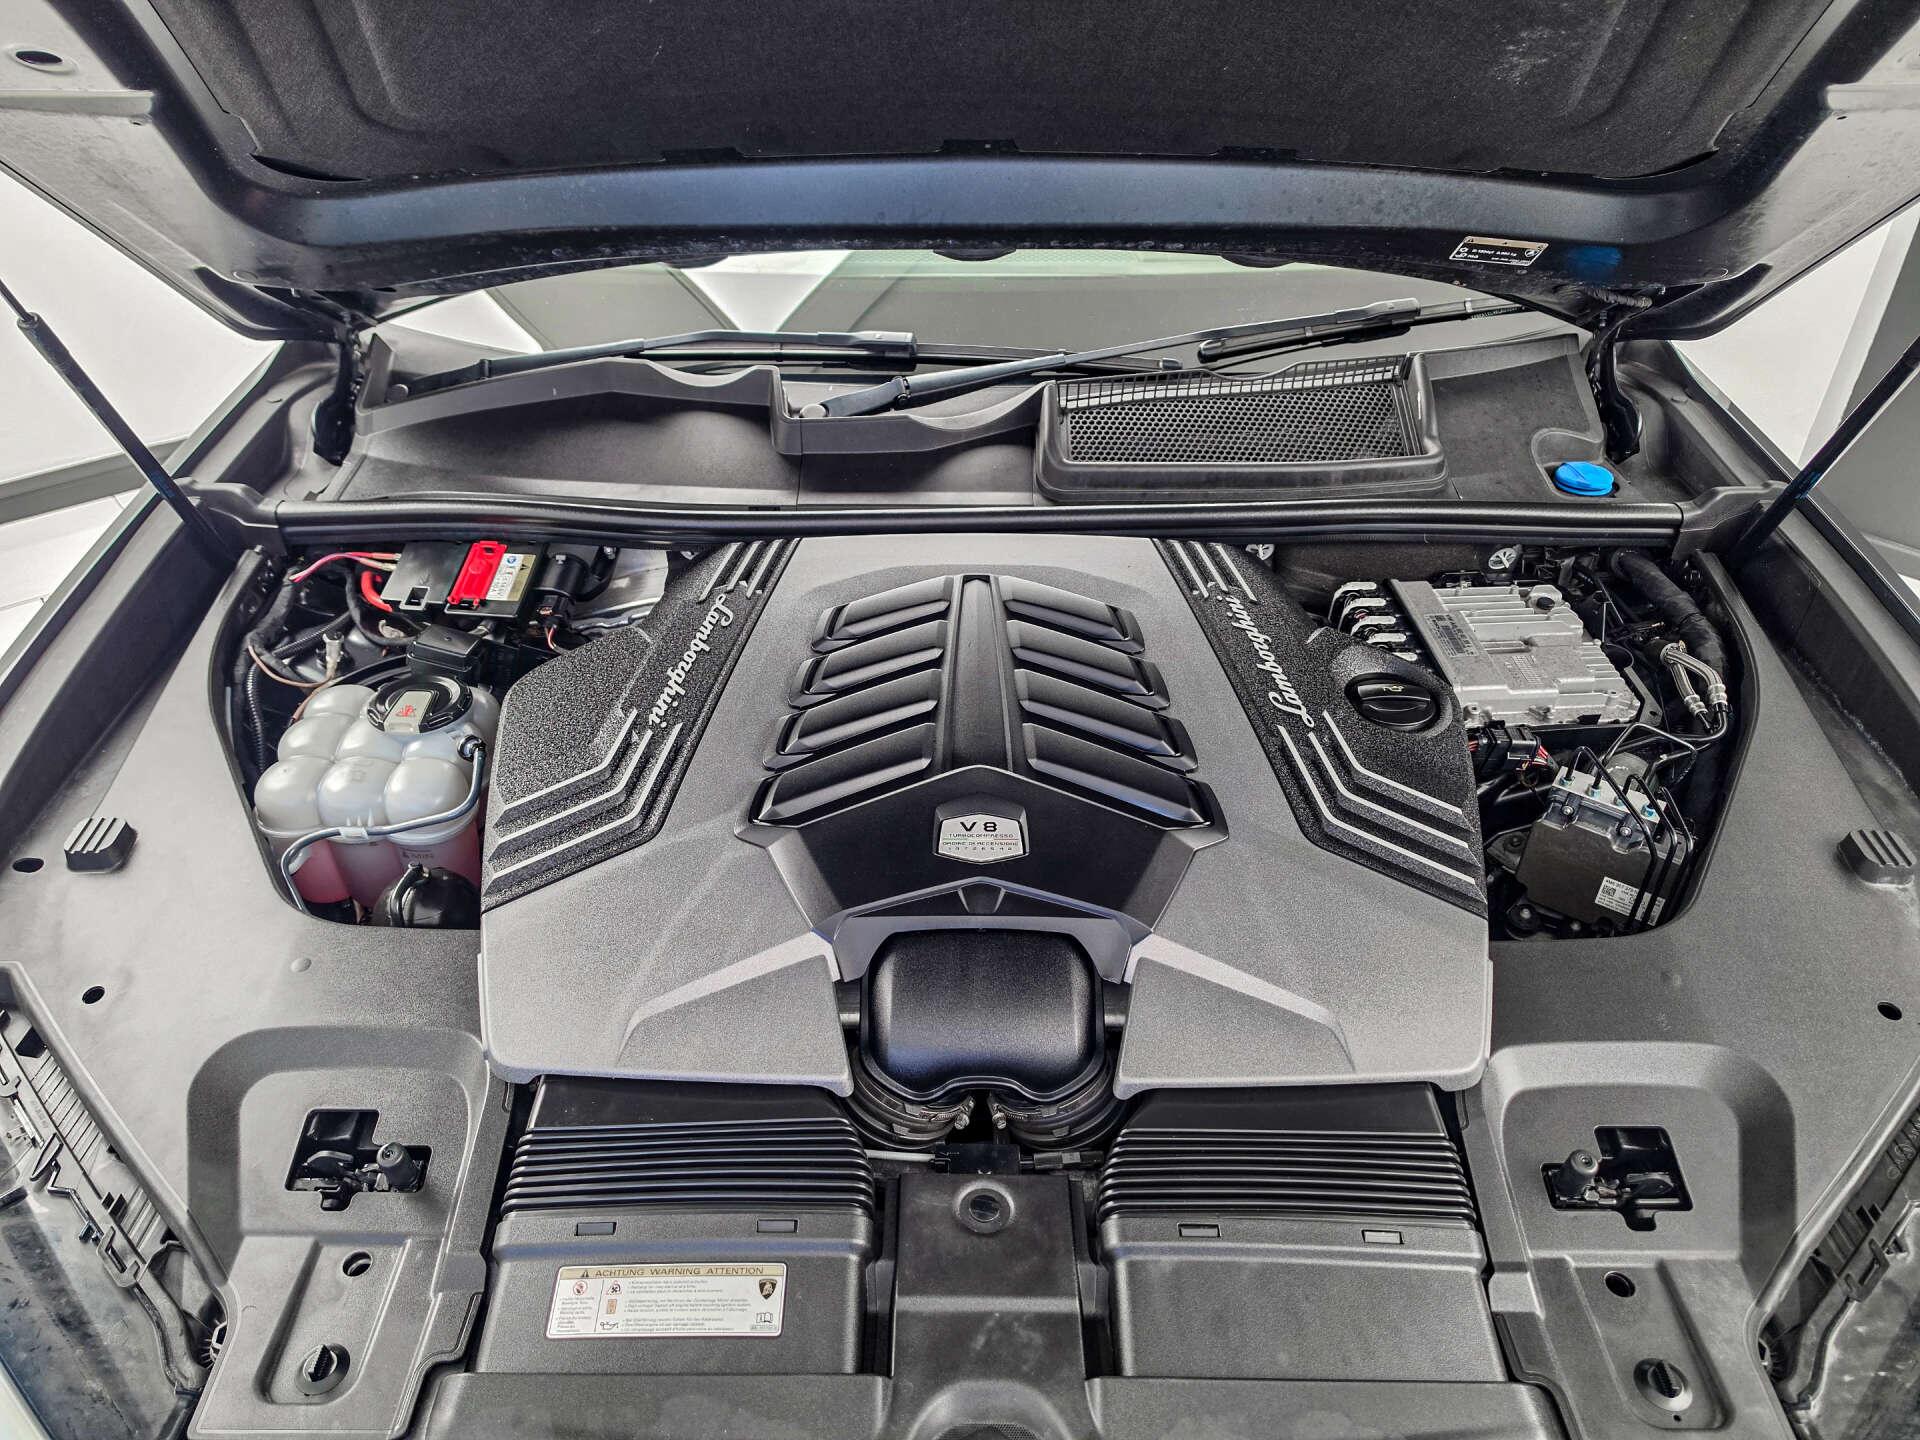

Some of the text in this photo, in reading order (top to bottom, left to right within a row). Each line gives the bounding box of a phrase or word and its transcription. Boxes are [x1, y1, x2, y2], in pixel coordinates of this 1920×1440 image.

[649, 593, 734, 728] Lamborghini
[1216, 594, 1315, 728] Lamborghini
[595, 1266, 764, 1277] ACHTUNG WARNING ATTENTION
